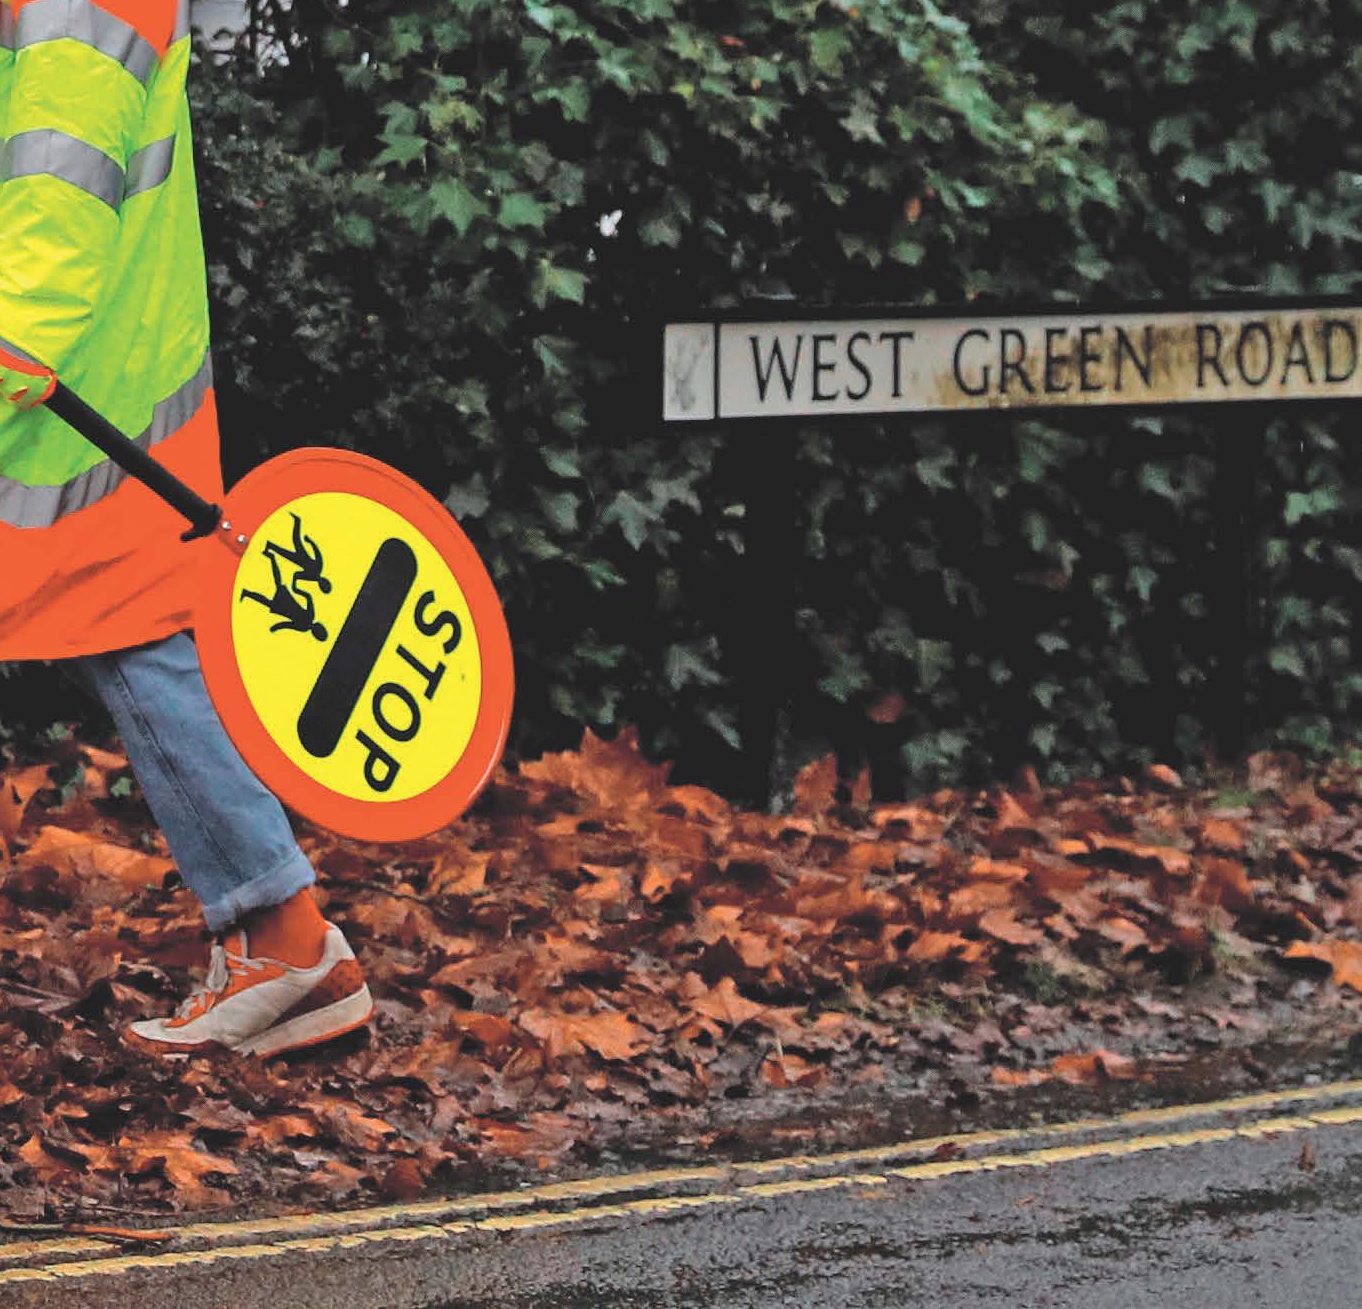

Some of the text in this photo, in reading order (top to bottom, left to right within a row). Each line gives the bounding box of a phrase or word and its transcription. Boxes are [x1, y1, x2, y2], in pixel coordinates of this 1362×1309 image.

[748, 318, 1359, 403] WEST GREEN ROAD
[354, 589, 463, 794] STOP
